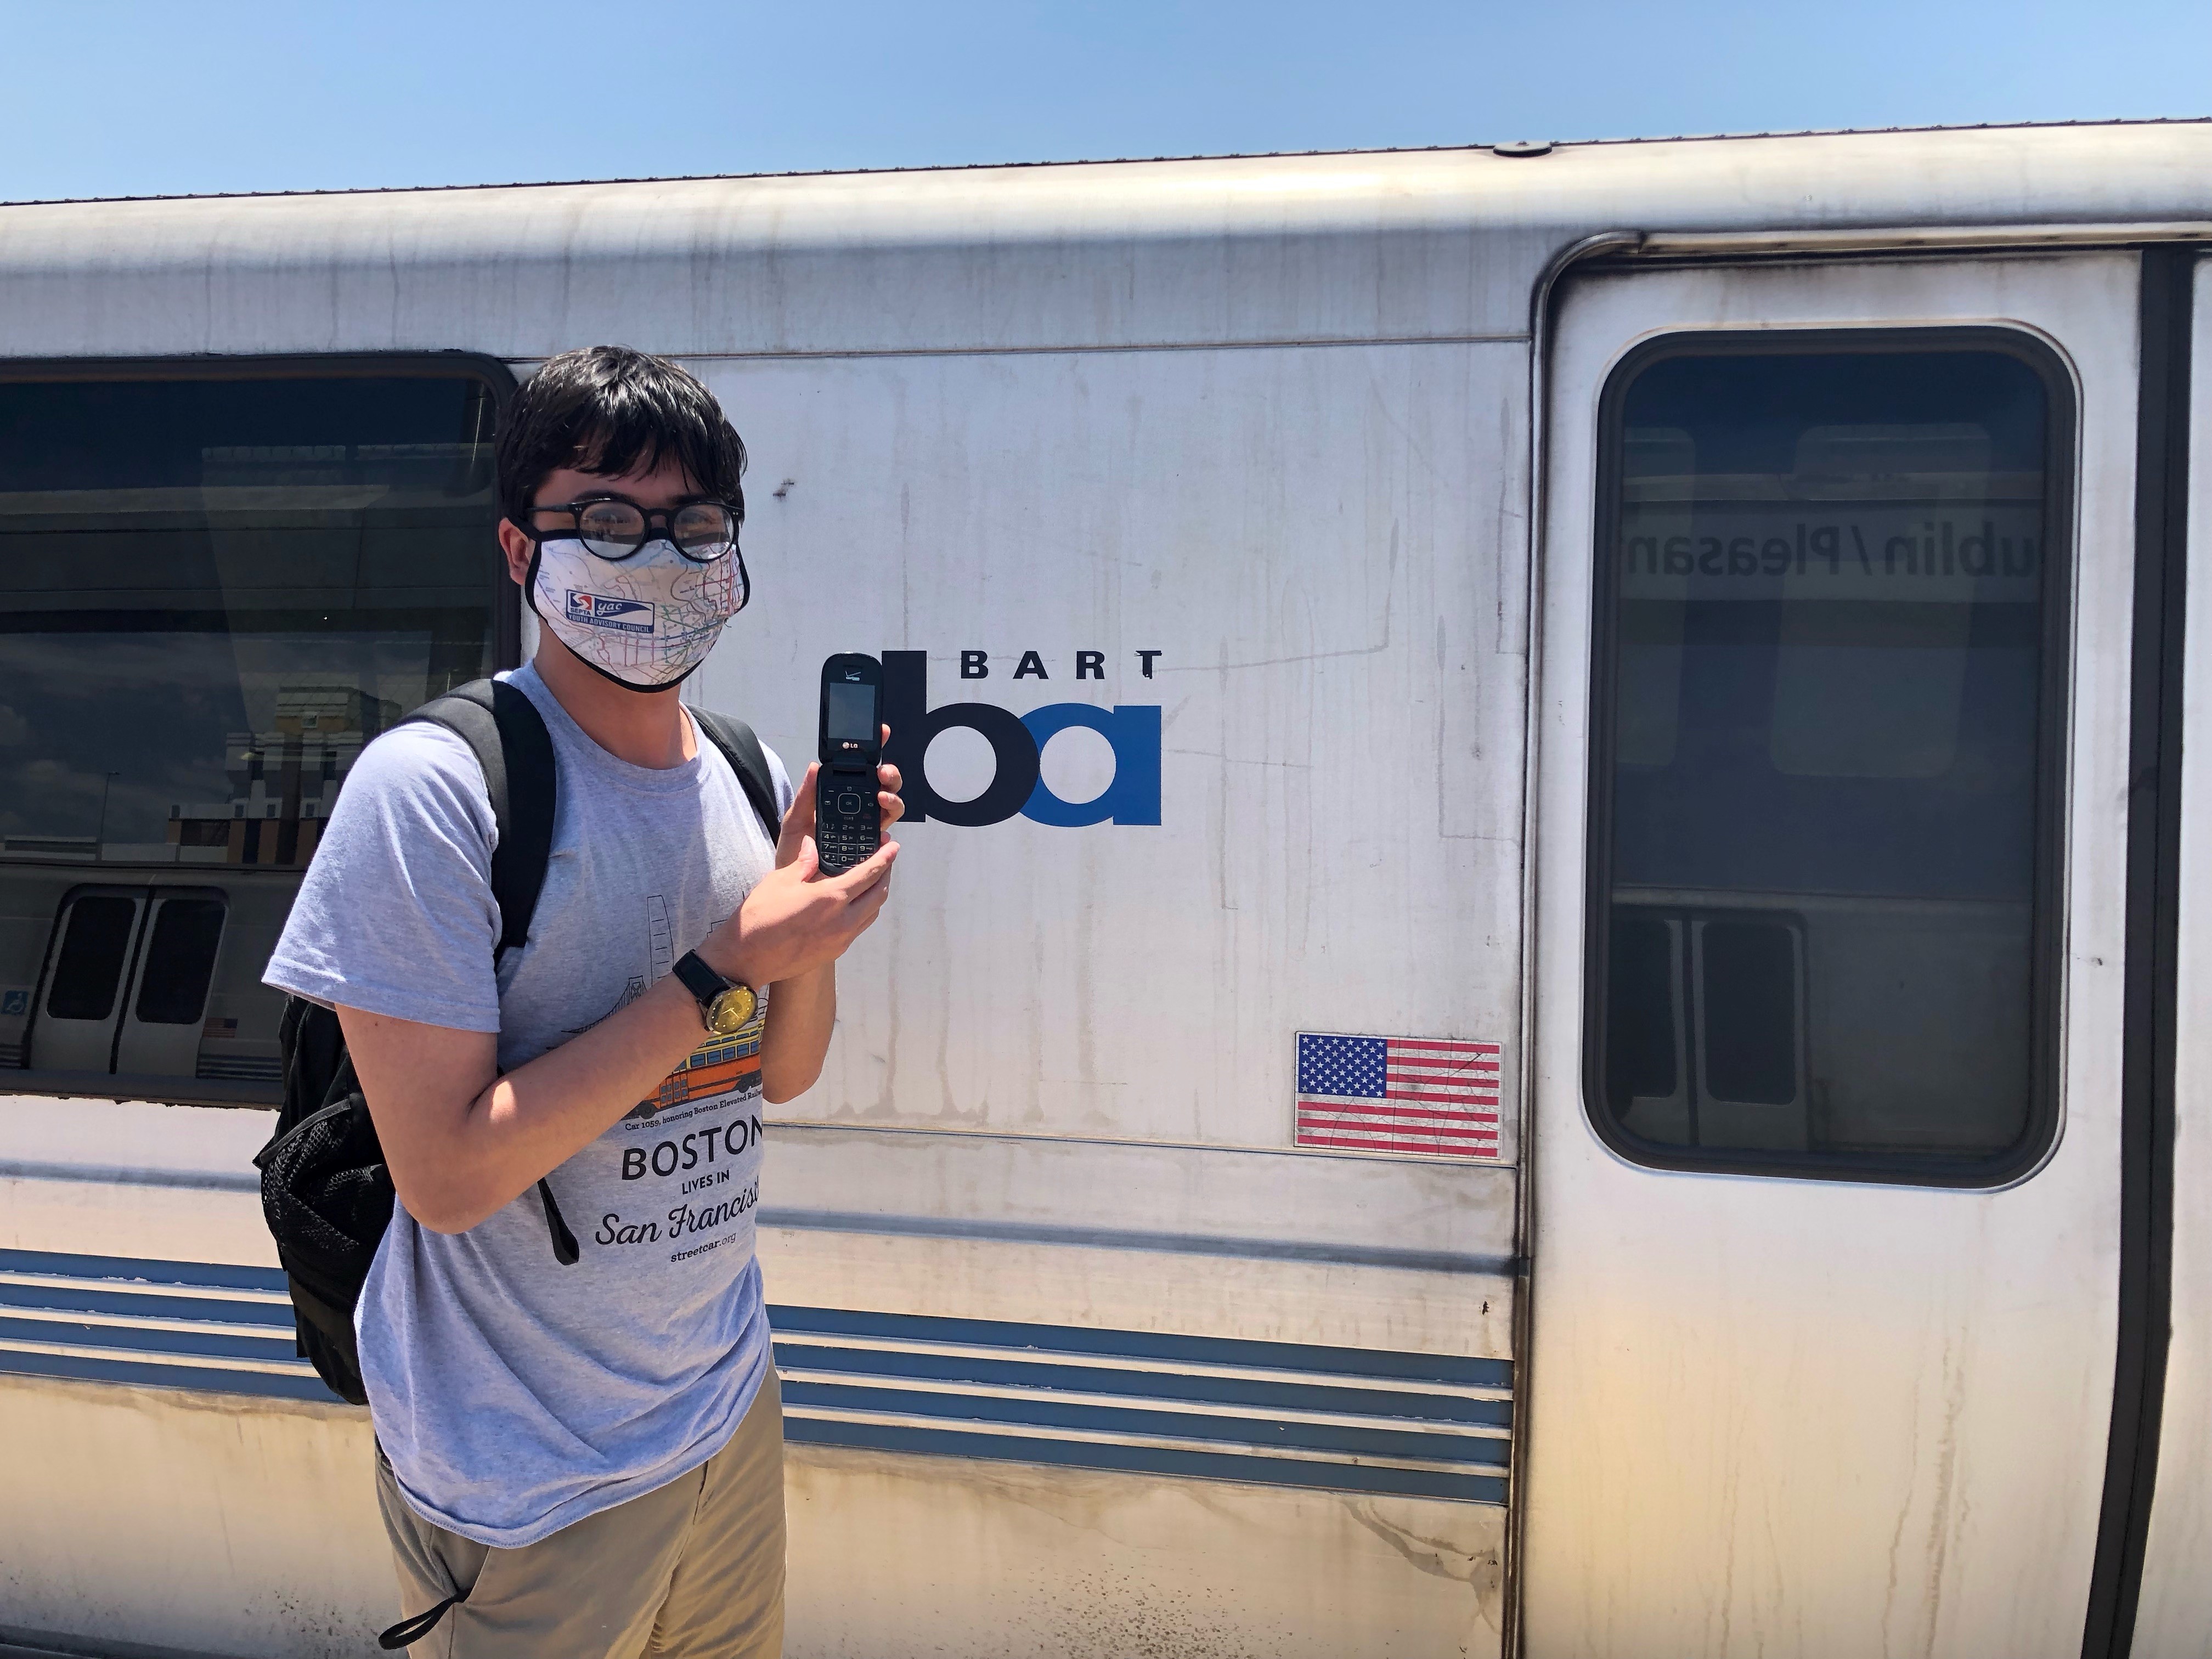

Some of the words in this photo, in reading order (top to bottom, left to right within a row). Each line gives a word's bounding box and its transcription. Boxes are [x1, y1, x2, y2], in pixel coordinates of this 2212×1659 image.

[568, 614, 588, 623] YOUTH
[590, 618, 621, 629] ADVISORY
[622, 624, 650, 633] COUNCIL
[570, 607, 591, 616] SEPTA
[597, 602, 623, 616] yac
[961, 650, 1162, 679] BART
[625, 1122, 639, 1131] Car
[641, 1119, 661, 1128] 1059,
[662, 1110, 693, 1124] honoring
[694, 1104, 718, 1115] Boston
[720, 1095, 747, 1108] Elevated
[622, 1114, 763, 1181] BOSTON
[681, 1174, 713, 1195] LIVES
[716, 1170, 730, 1184] IN
[595, 1213, 662, 1245] San
[670, 1231, 736, 1263] streetcar.org
